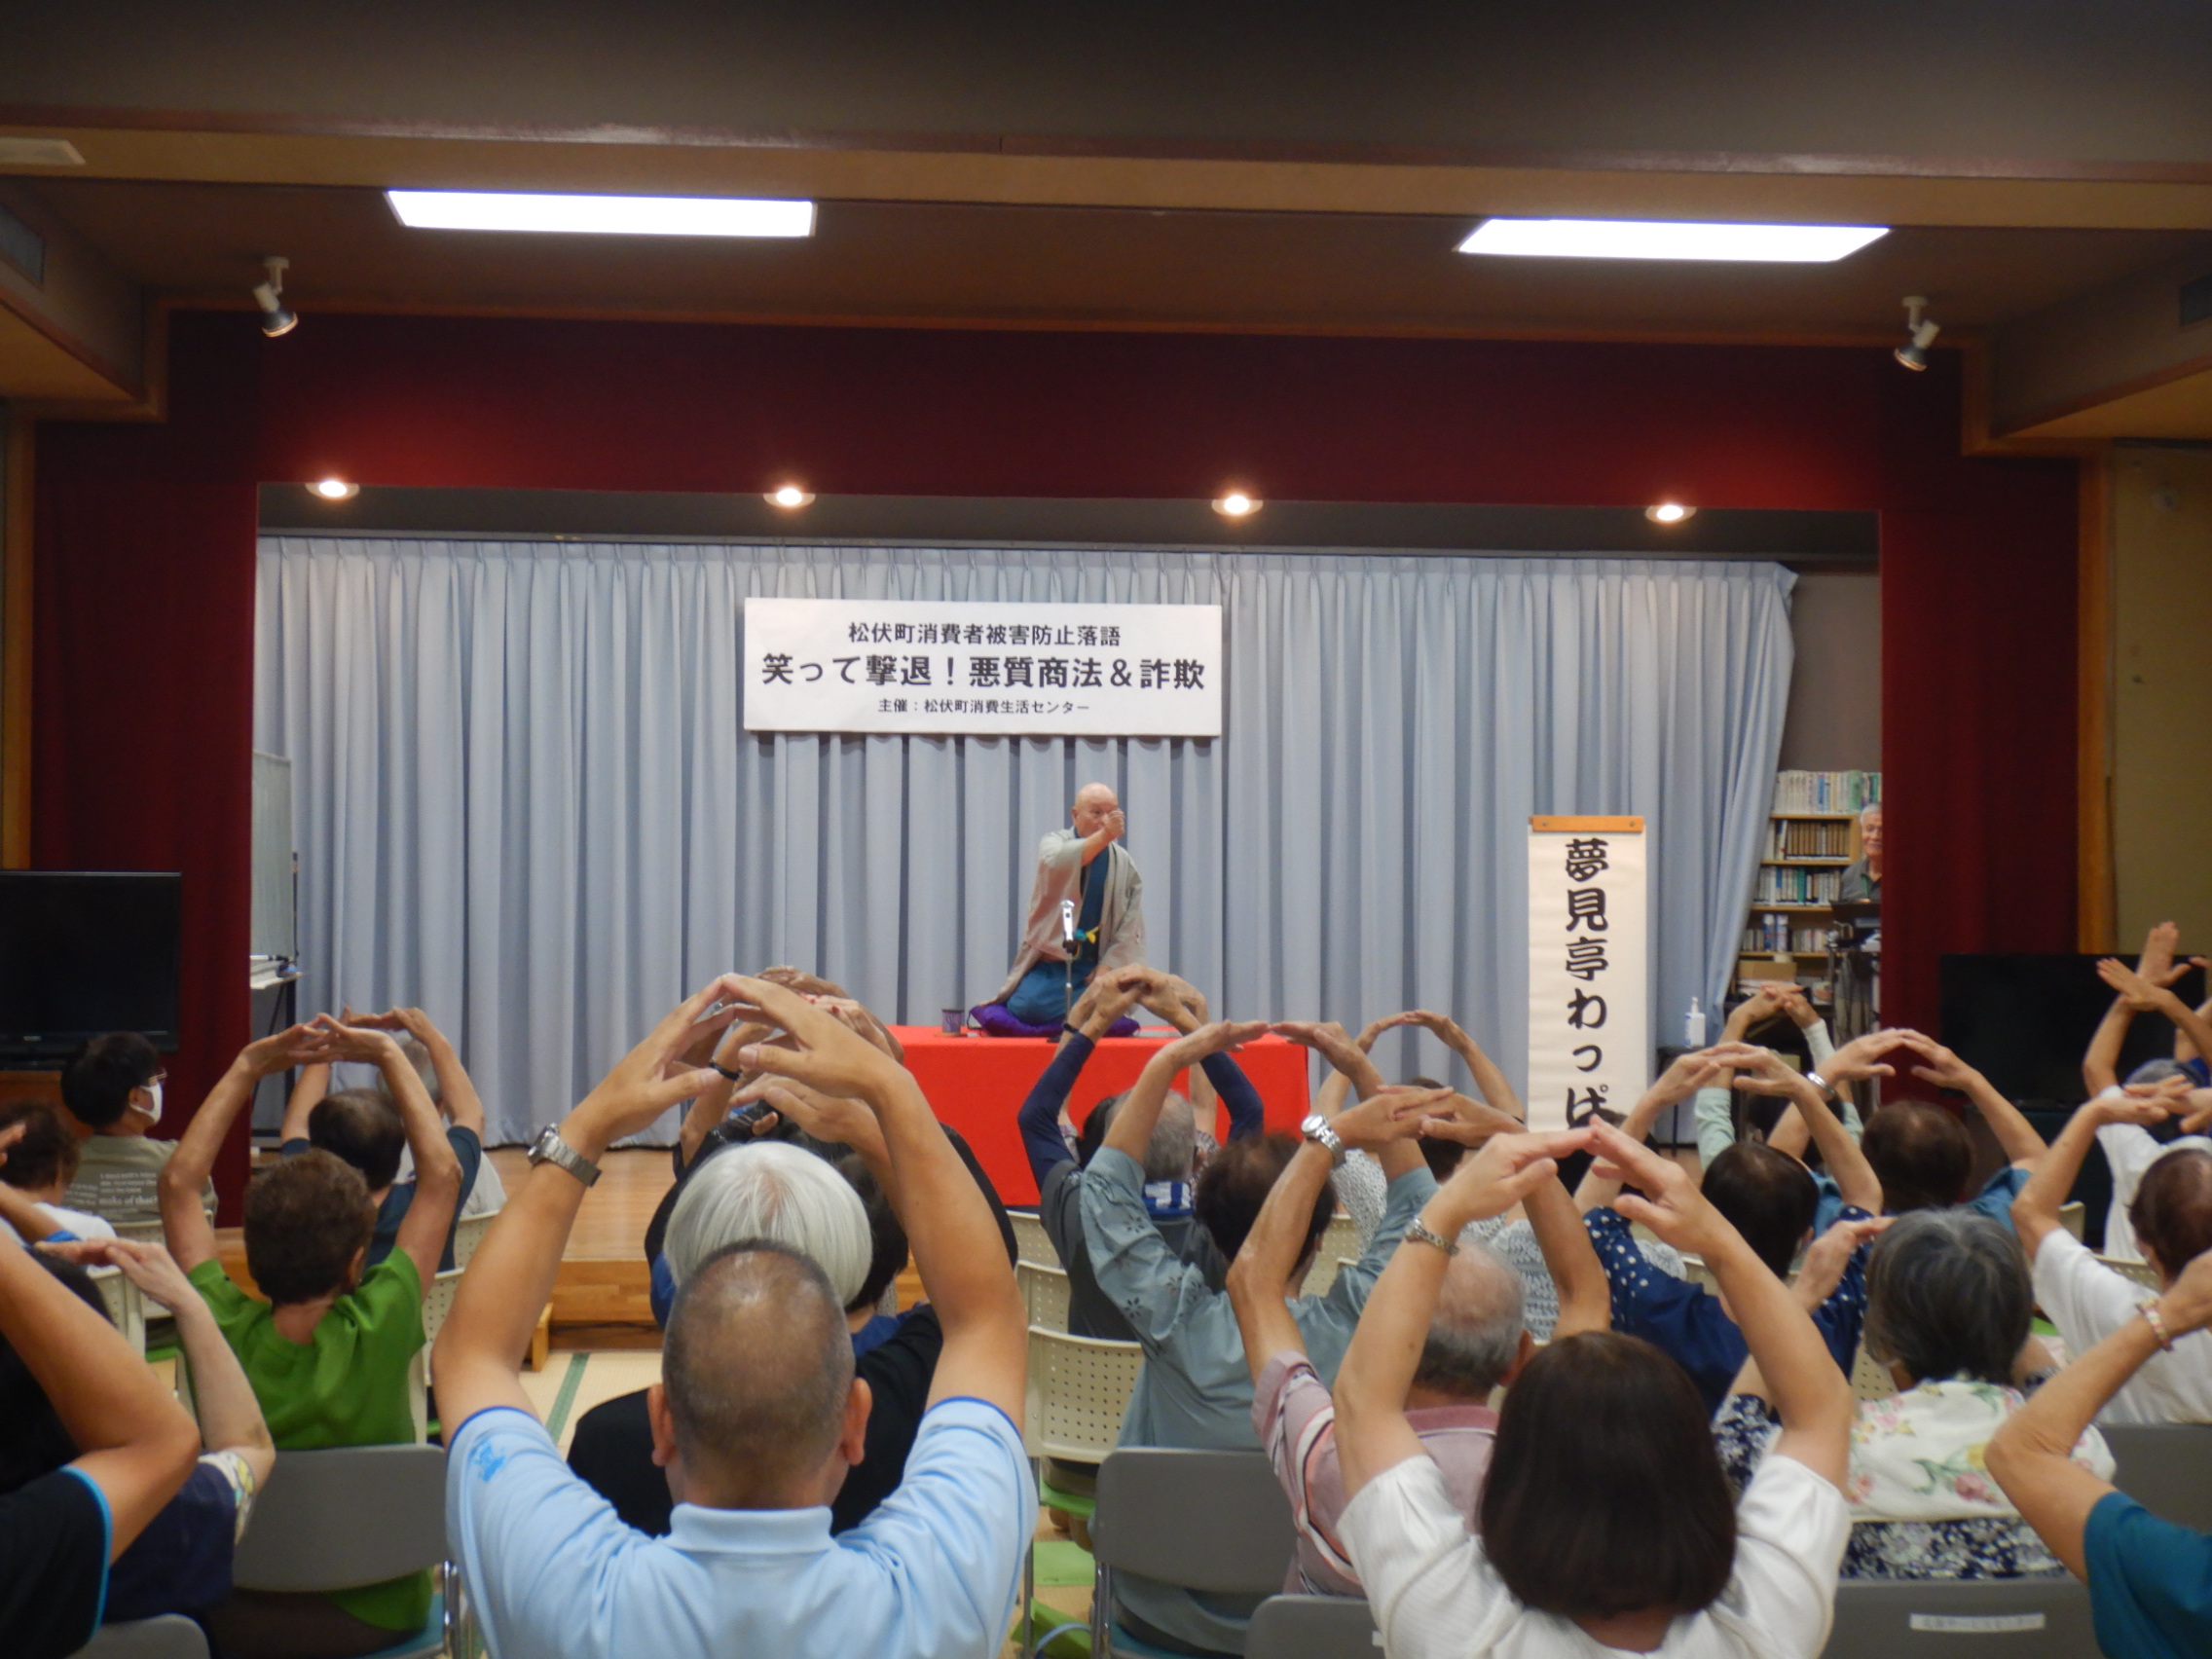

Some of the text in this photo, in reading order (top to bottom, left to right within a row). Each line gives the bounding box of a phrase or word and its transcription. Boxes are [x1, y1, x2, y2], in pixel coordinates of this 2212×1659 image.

[848, 622, 1121, 646] 松伏町消費者被害防止落語
[761, 653, 1205, 689] 笑って撃退！悪質商法＆詐欺
